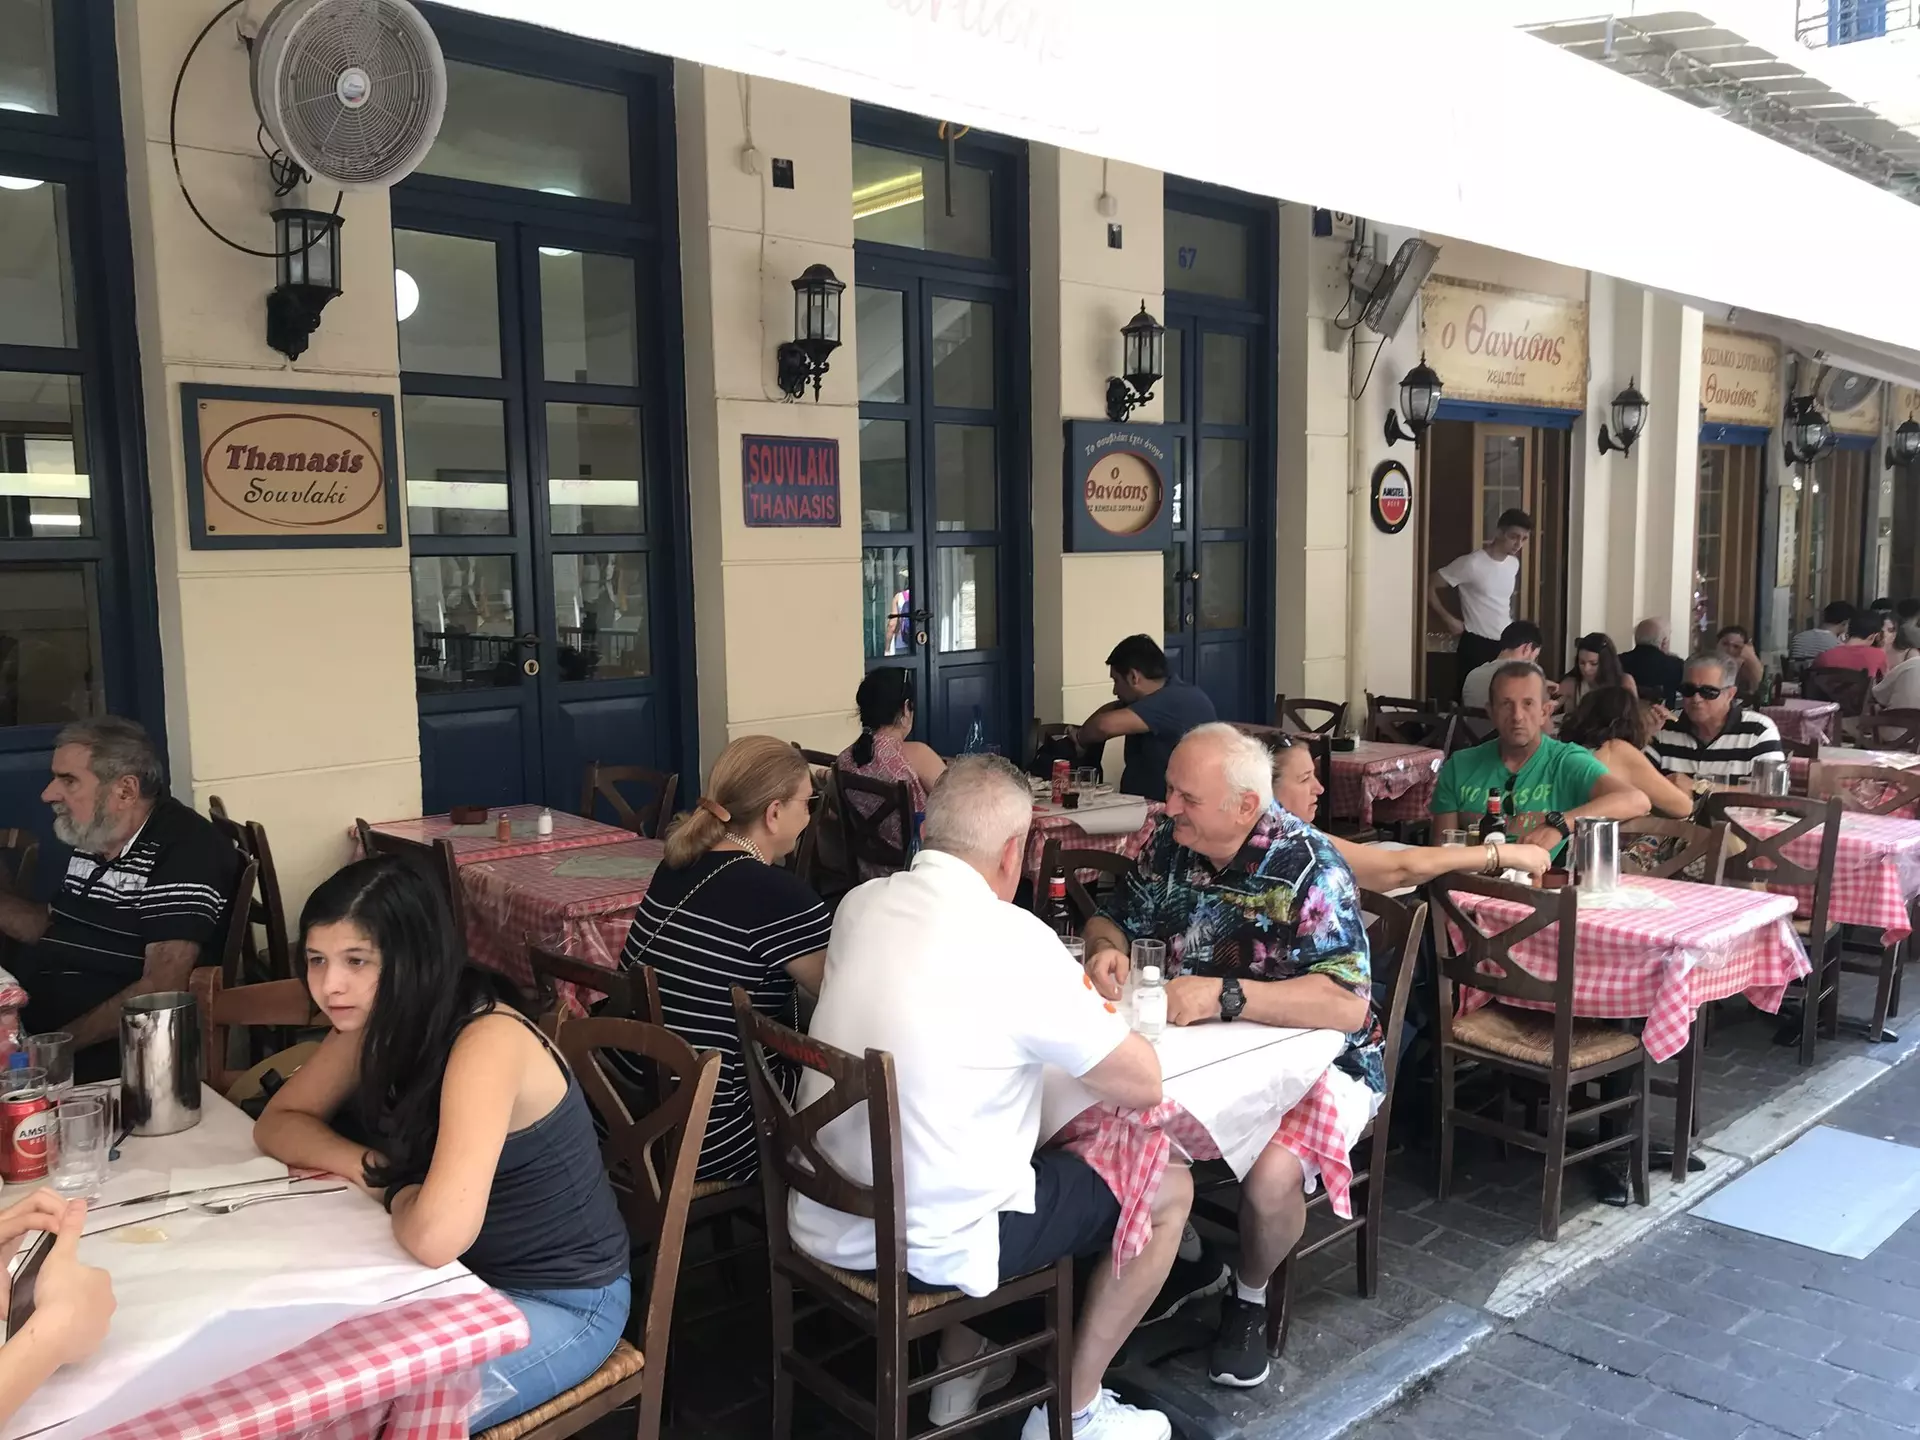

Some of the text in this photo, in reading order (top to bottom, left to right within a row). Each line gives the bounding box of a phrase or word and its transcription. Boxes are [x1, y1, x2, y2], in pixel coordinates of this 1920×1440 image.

[1178, 246, 1197, 270] 67
[226, 444, 364, 473] Thanasis
[749, 444, 835, 486] SOUVLAKI
[244, 477, 348, 504] Souvlaki
[1382, 488, 1405, 497] AMSTEL
[750, 494, 835, 520] THANASIS
